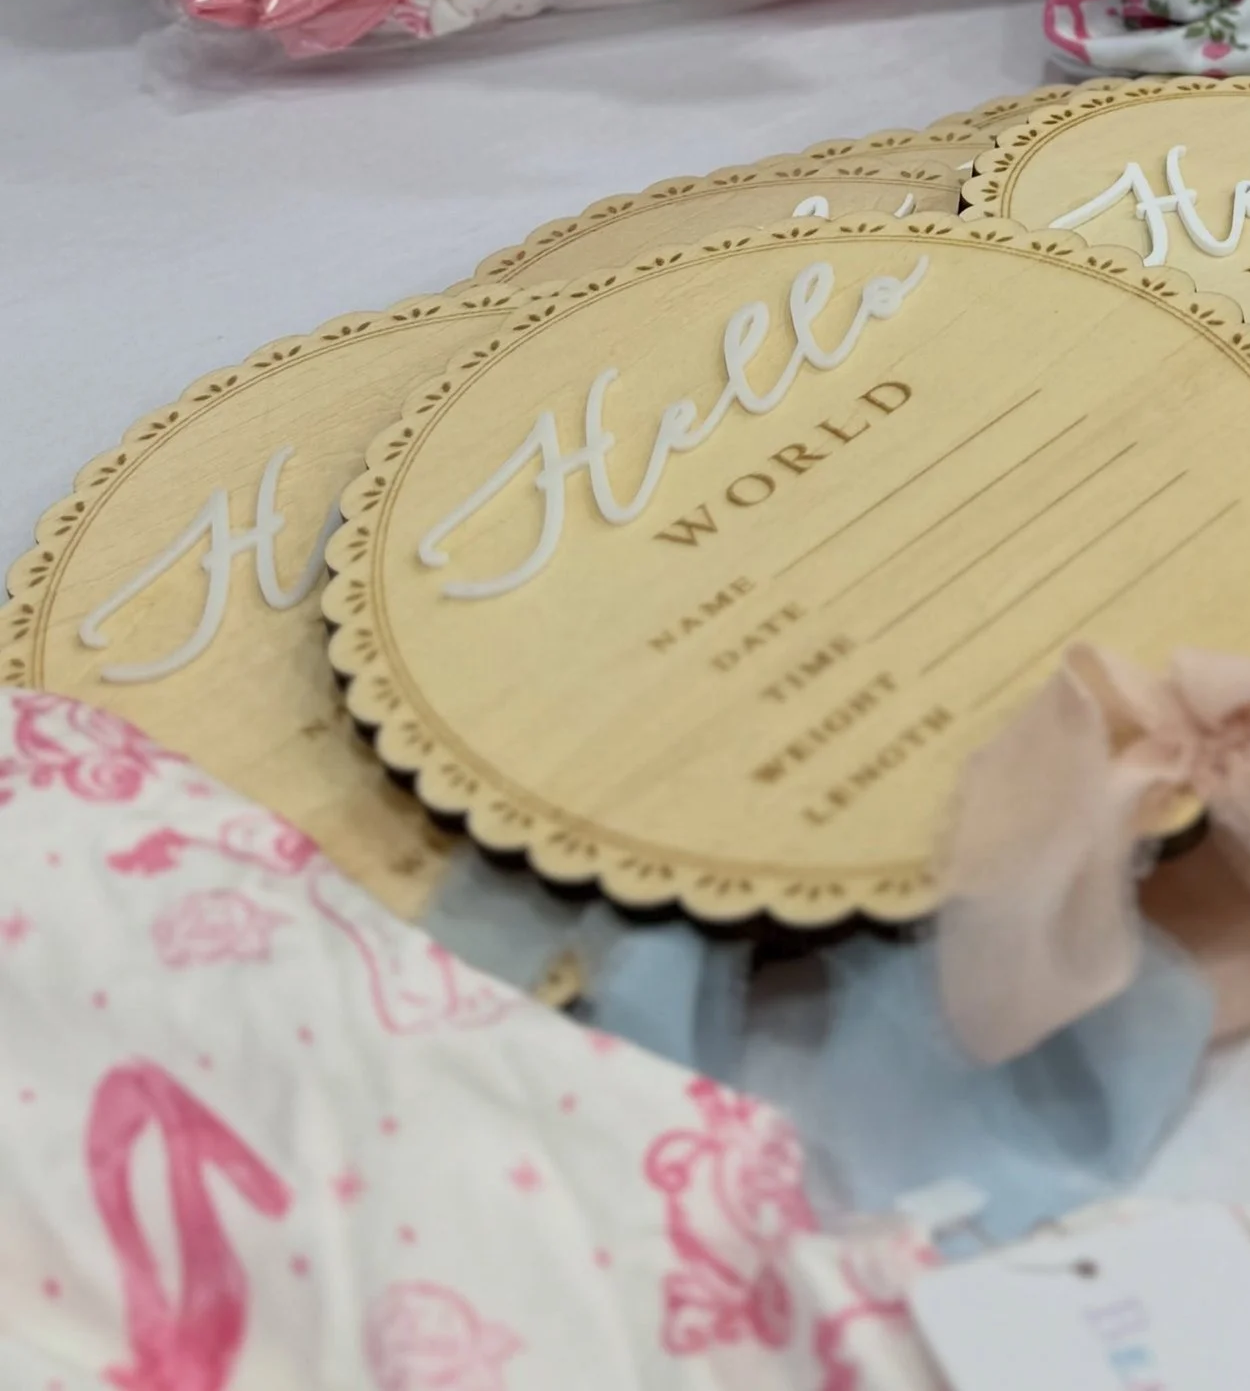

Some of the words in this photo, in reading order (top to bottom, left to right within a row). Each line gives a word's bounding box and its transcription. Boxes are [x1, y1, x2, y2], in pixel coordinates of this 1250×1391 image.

[418, 254, 930, 600] Hello
[652, 380, 913, 547] WORLD
[649, 575, 756, 653] NAME
[710, 603, 806, 673] DATE
[760, 634, 857, 704] TIME
[750, 671, 898, 785] WEIGHT
[803, 706, 954, 828] LENGTH
